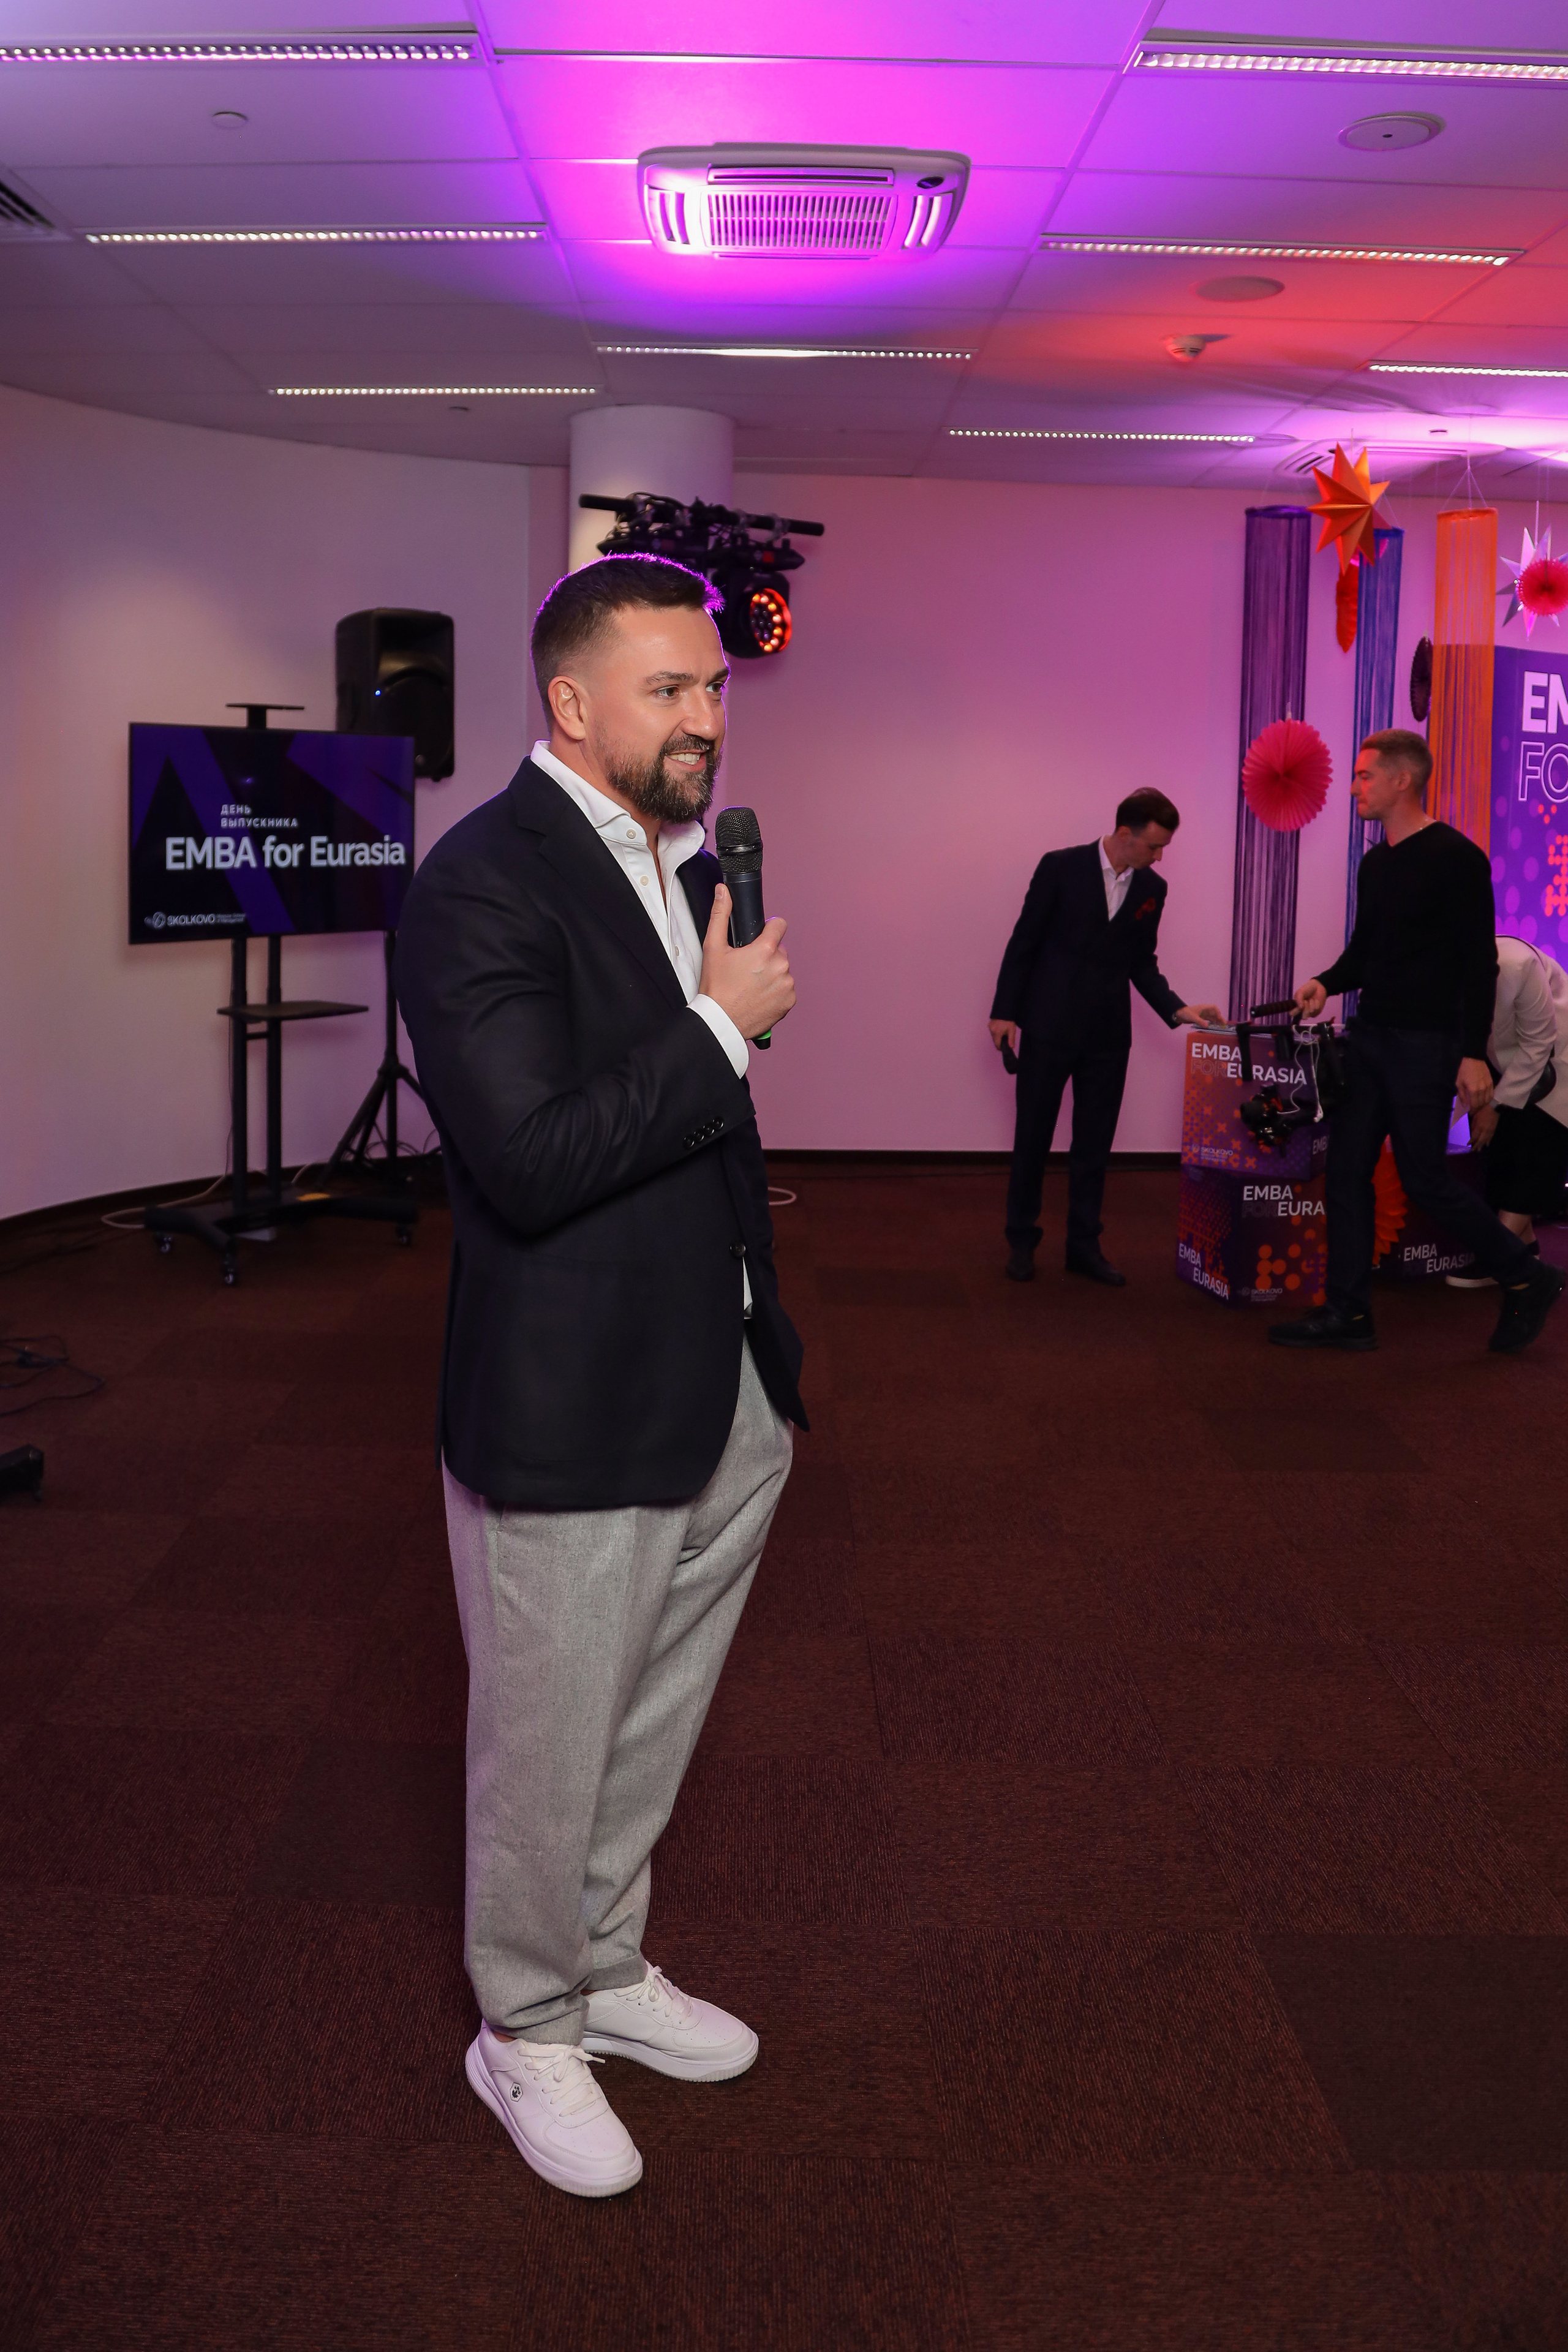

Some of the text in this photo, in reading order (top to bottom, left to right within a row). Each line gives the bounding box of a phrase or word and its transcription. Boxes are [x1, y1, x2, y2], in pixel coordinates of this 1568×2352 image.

[1518, 741, 1568, 804] FO
[221, 804, 252, 815] ДЕНЬ
[221, 818, 298, 829] ВЫПУСКНИКА
[165, 835, 405, 870] EMBA for Eurasia
[167, 913, 216, 927] SKOLKOVO
[1191, 1042, 1242, 1061] EMBA
[1313, 1136, 1328, 1155] EMB
[1243, 1185, 1294, 1201] EMBA
[1278, 1200, 1325, 1216] EURA
[1178, 1243, 1202, 1267] EMBA
[1403, 1243, 1438, 1262] EMBA
[1193, 1267, 1229, 1300] EURASIA
